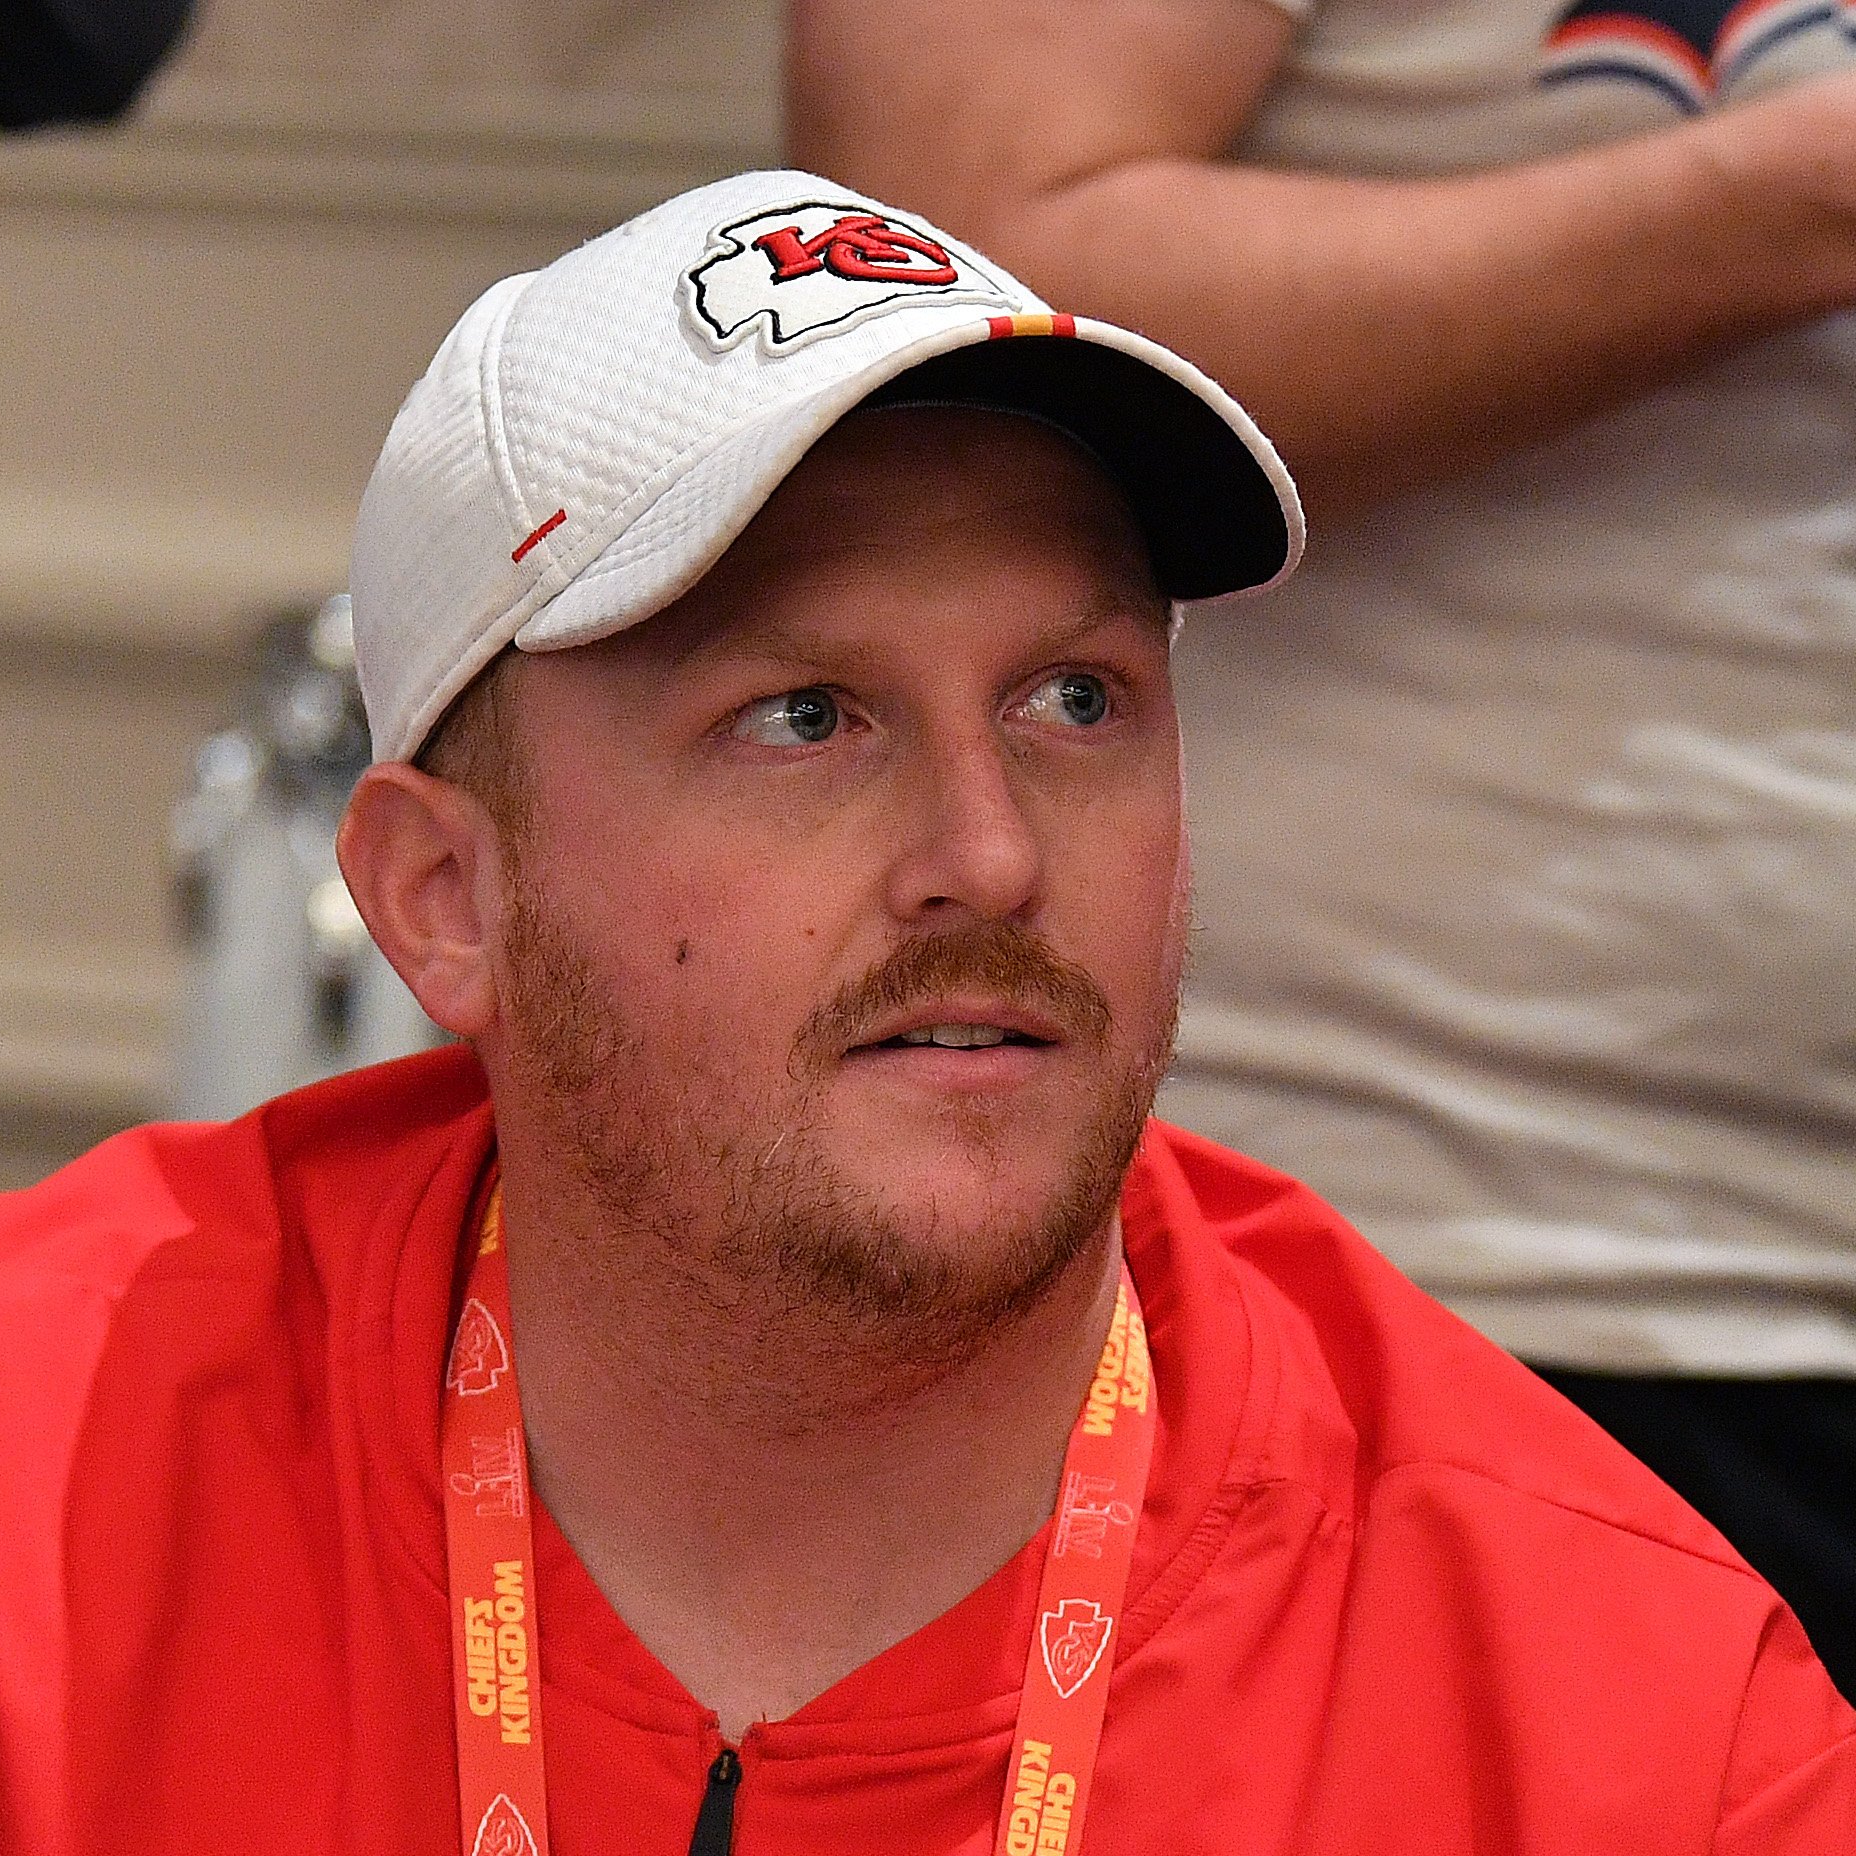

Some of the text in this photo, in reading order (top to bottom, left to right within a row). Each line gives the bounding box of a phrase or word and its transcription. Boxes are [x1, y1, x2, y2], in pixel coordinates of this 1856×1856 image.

[751, 216, 958, 286] KC
[464, 1597, 497, 1717] CHIEFS
[494, 1560, 531, 1745] KINGDOM
